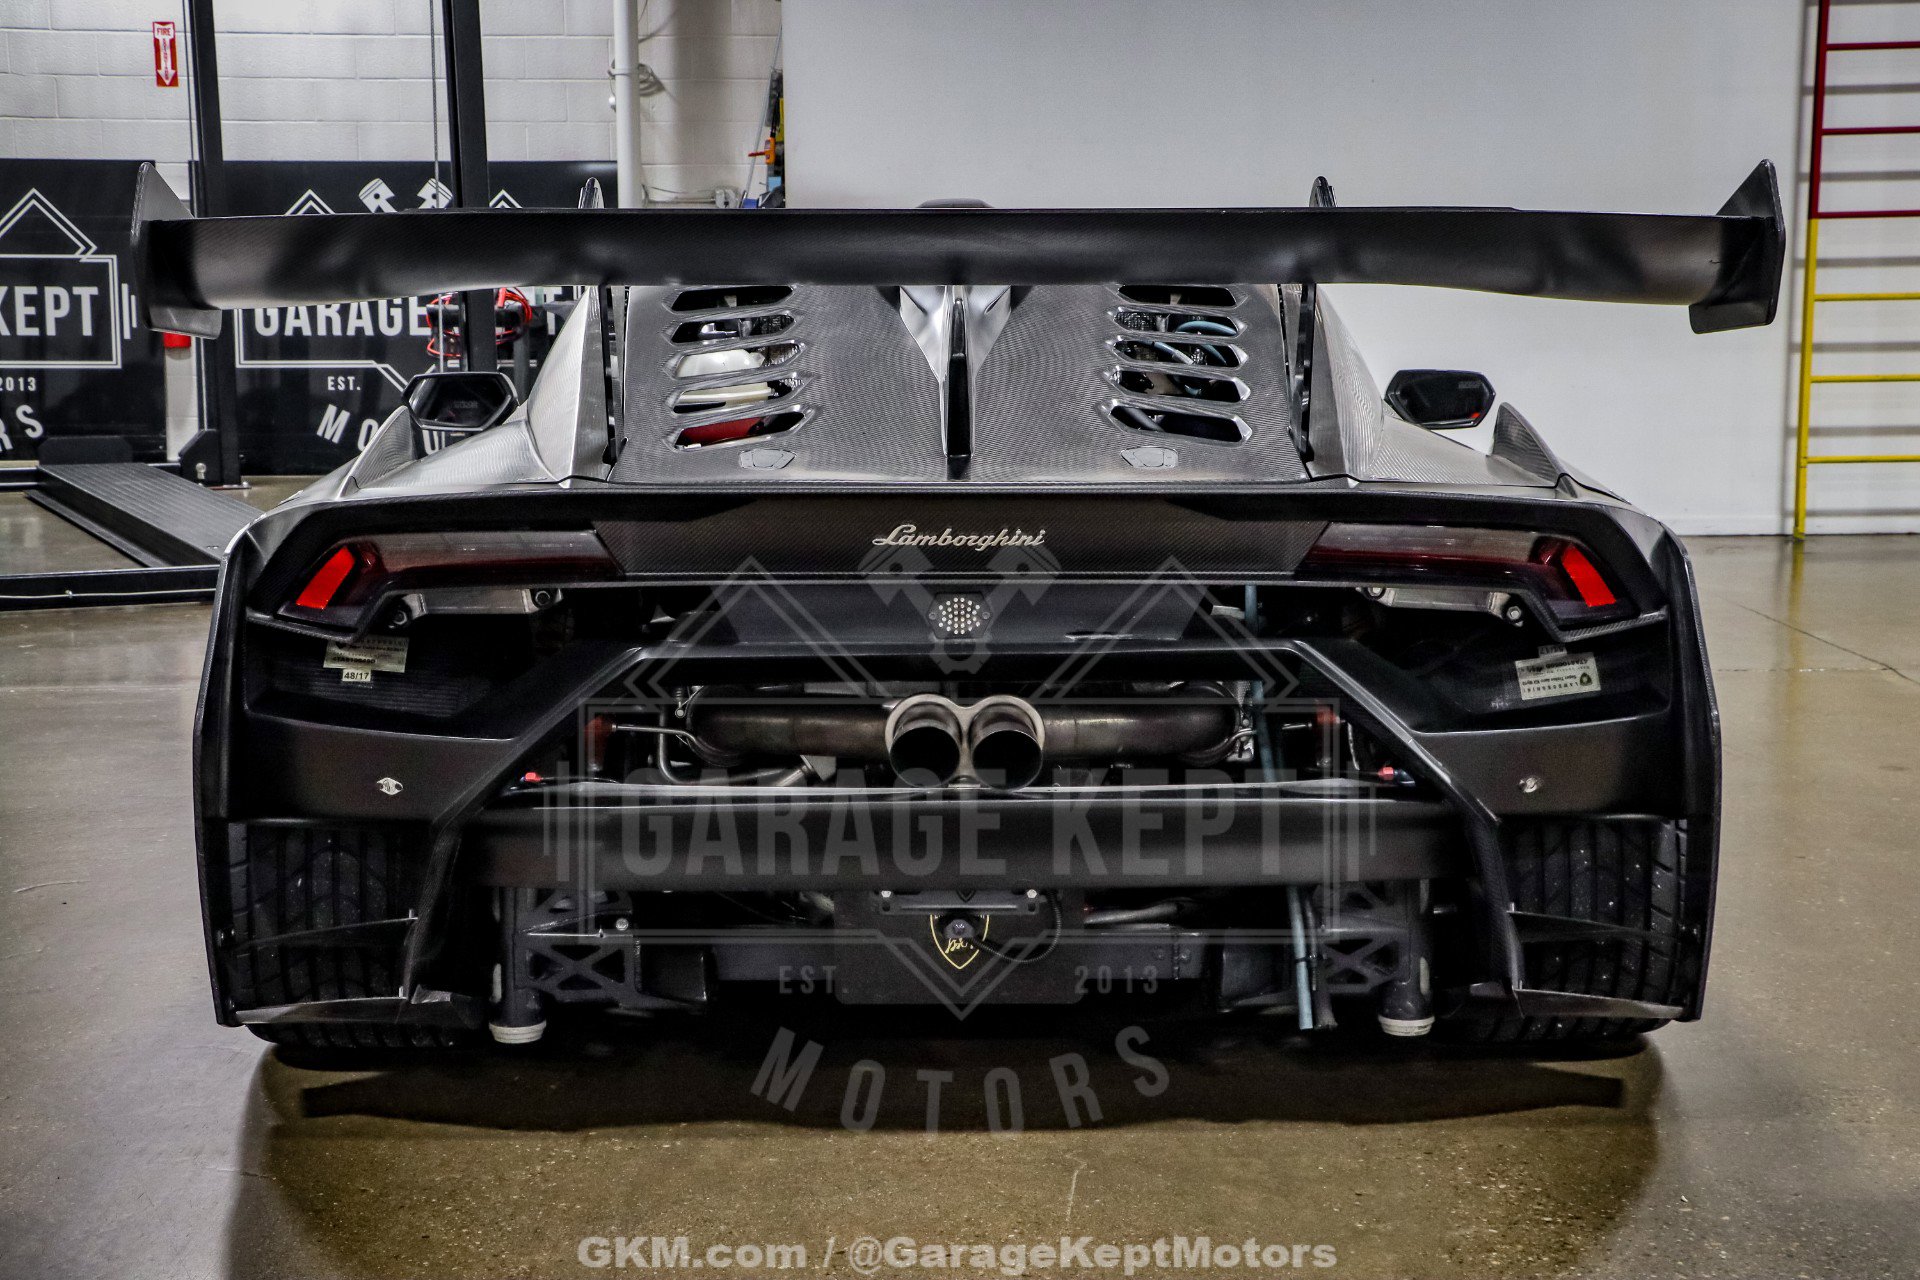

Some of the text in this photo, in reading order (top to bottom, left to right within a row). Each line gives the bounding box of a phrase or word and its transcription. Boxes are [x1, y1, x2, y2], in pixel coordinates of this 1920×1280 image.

[157, 27, 171, 36] FIRE
[327, 376, 361, 391] EST.
[872, 524, 1046, 551] Lamborghini
[344, 671, 370, 680] 48/17
